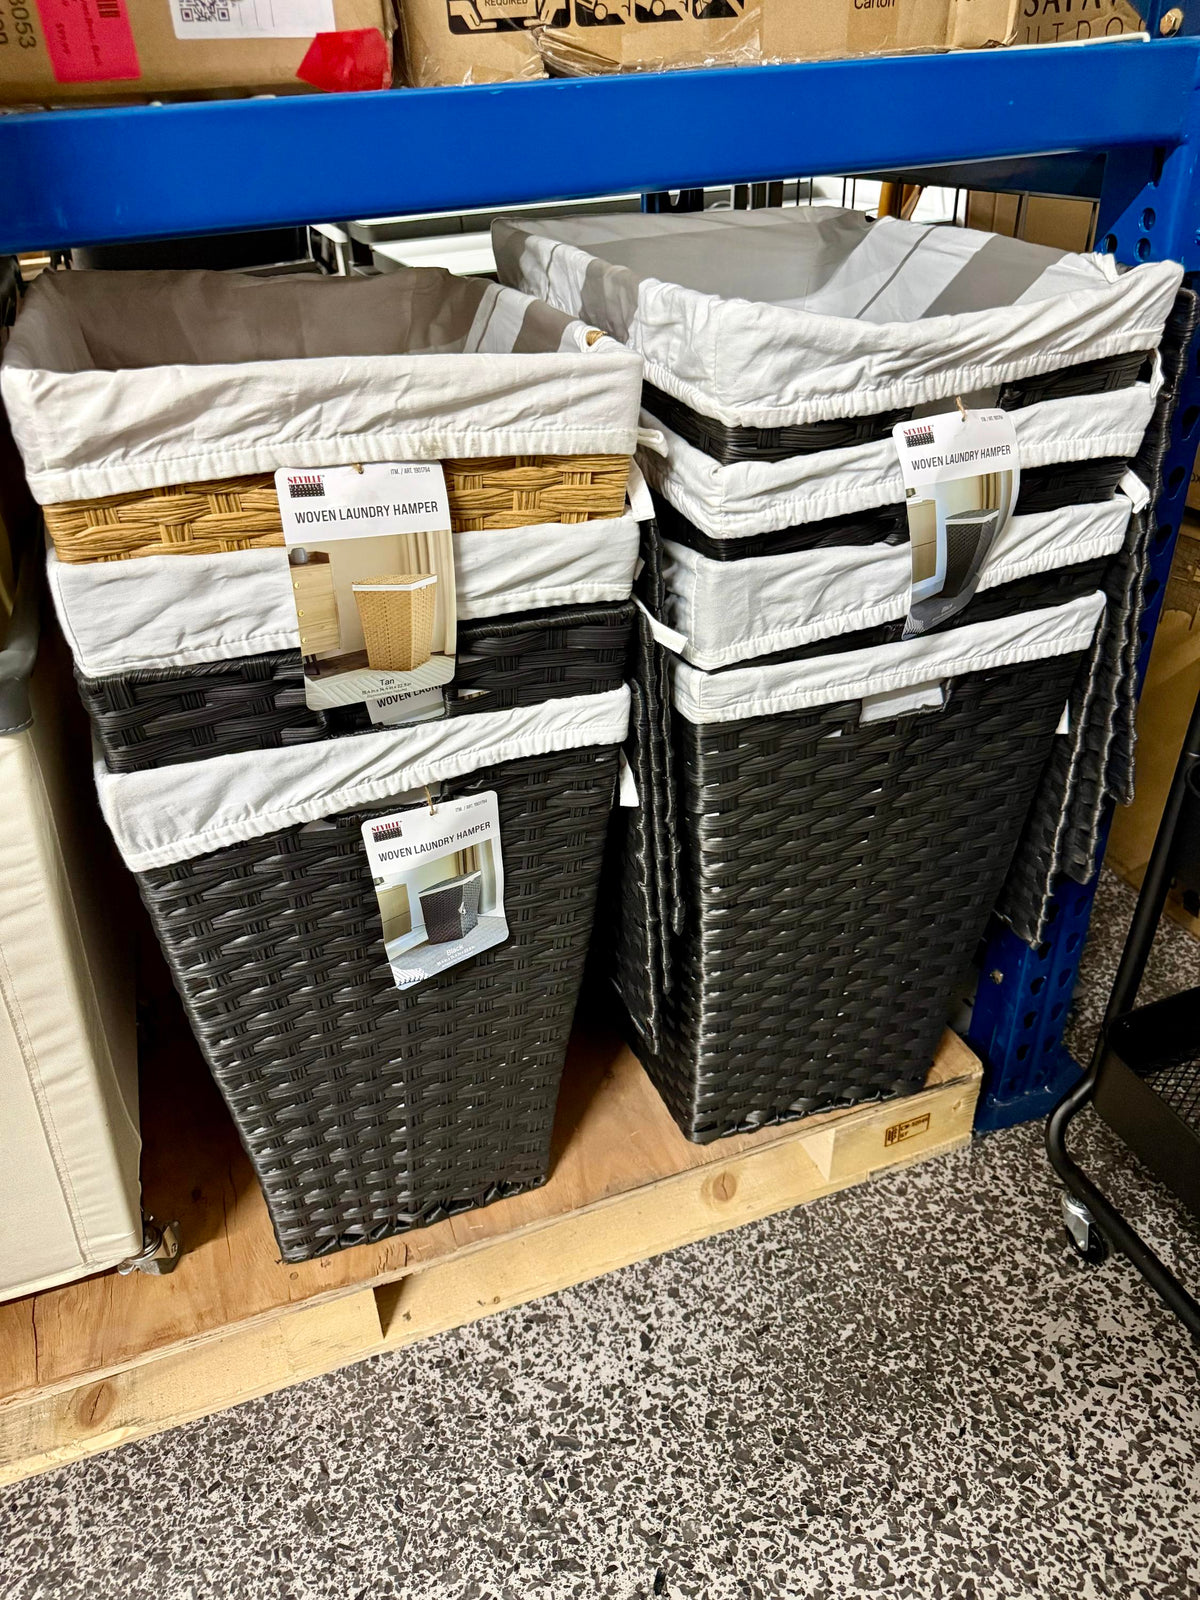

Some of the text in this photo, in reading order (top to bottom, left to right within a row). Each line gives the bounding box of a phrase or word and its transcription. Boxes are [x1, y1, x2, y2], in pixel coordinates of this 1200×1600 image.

[854, 0, 895, 9] Carton
[911, 444, 1011, 471] WOVEN LAUNDRY HAMPER
[287, 474, 322, 484] SEVILLE
[294, 500, 439, 524] WOVEN LAUNDRY HAMPER
[380, 678, 395, 686] Tan
[376, 692, 412, 708] WOVEN
[378, 821, 491, 862] WOVEN LAUNDRY HAMPER
